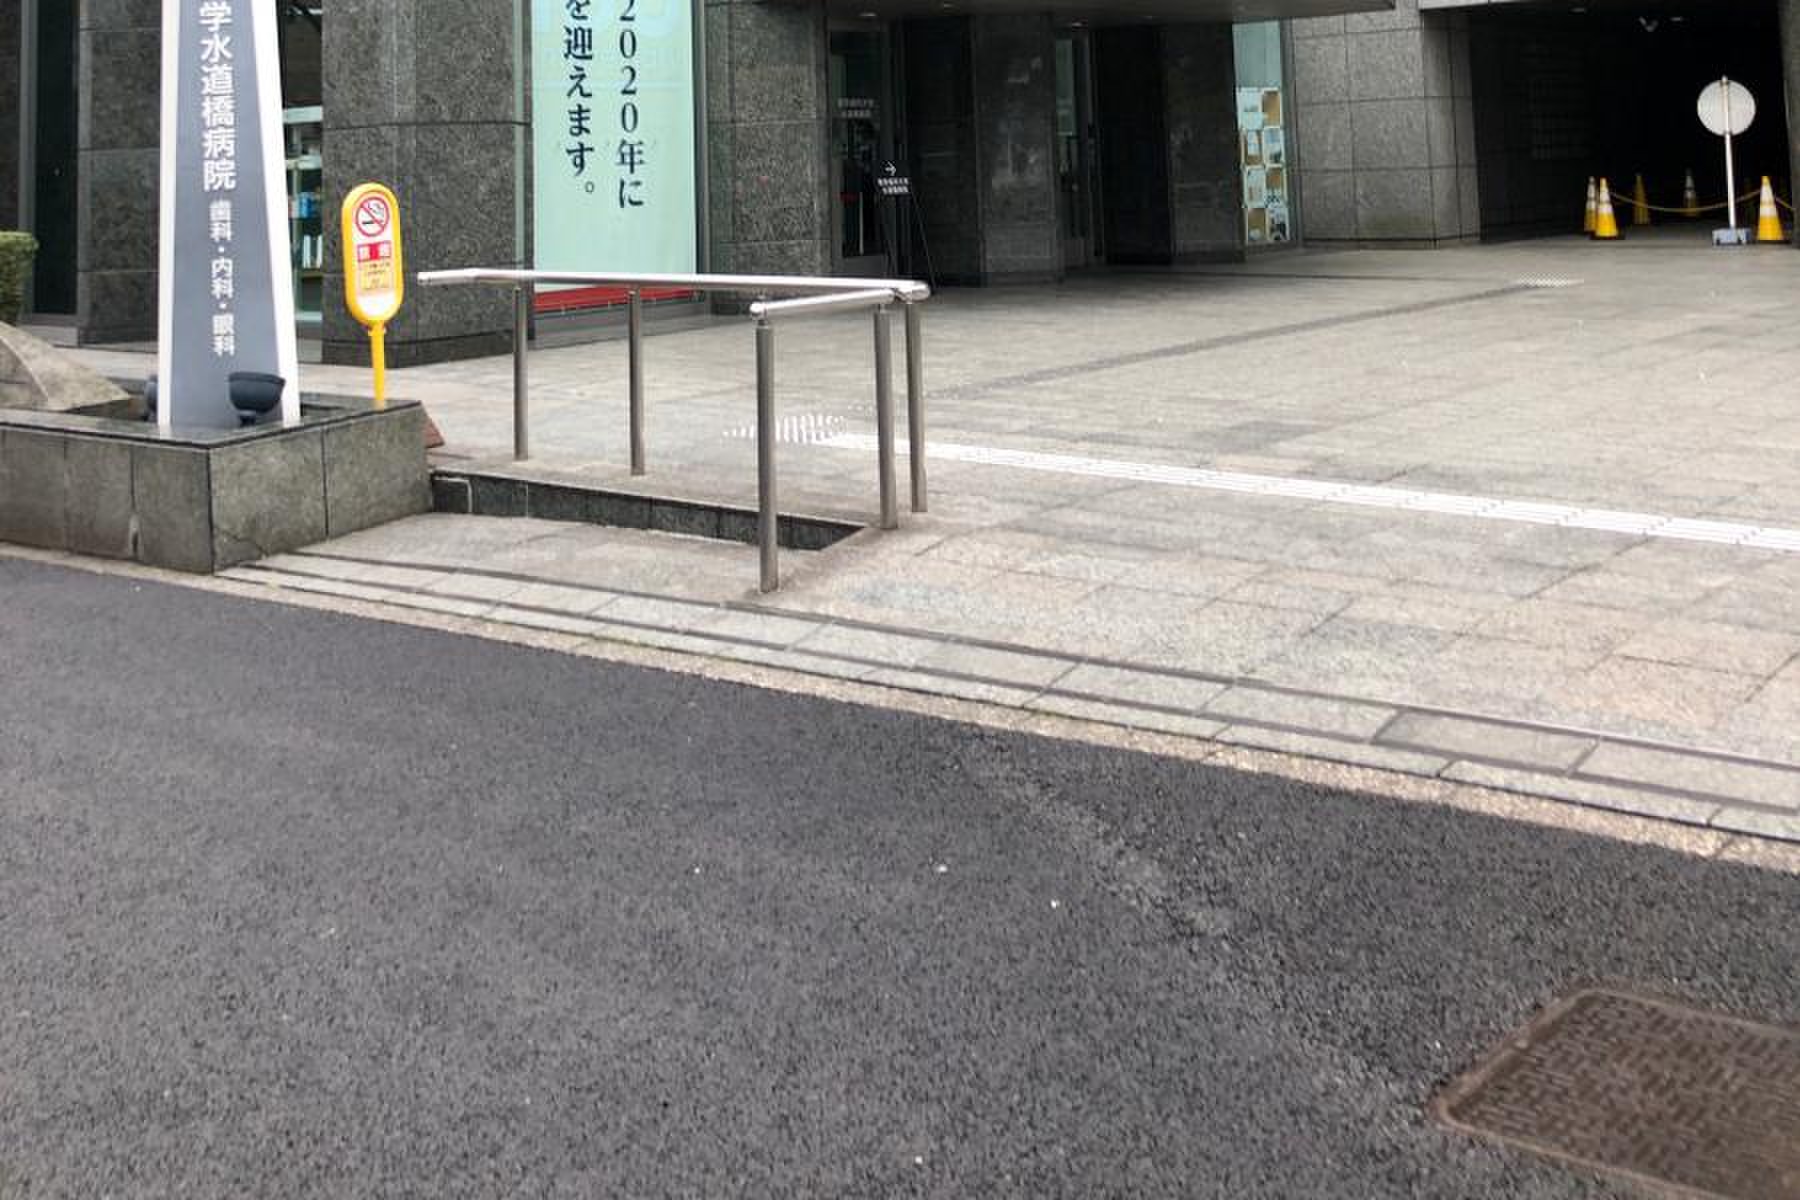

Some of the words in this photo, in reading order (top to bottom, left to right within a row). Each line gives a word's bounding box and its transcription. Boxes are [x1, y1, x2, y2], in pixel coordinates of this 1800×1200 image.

[208, 200, 236, 356] 歯科・内科・眼科
